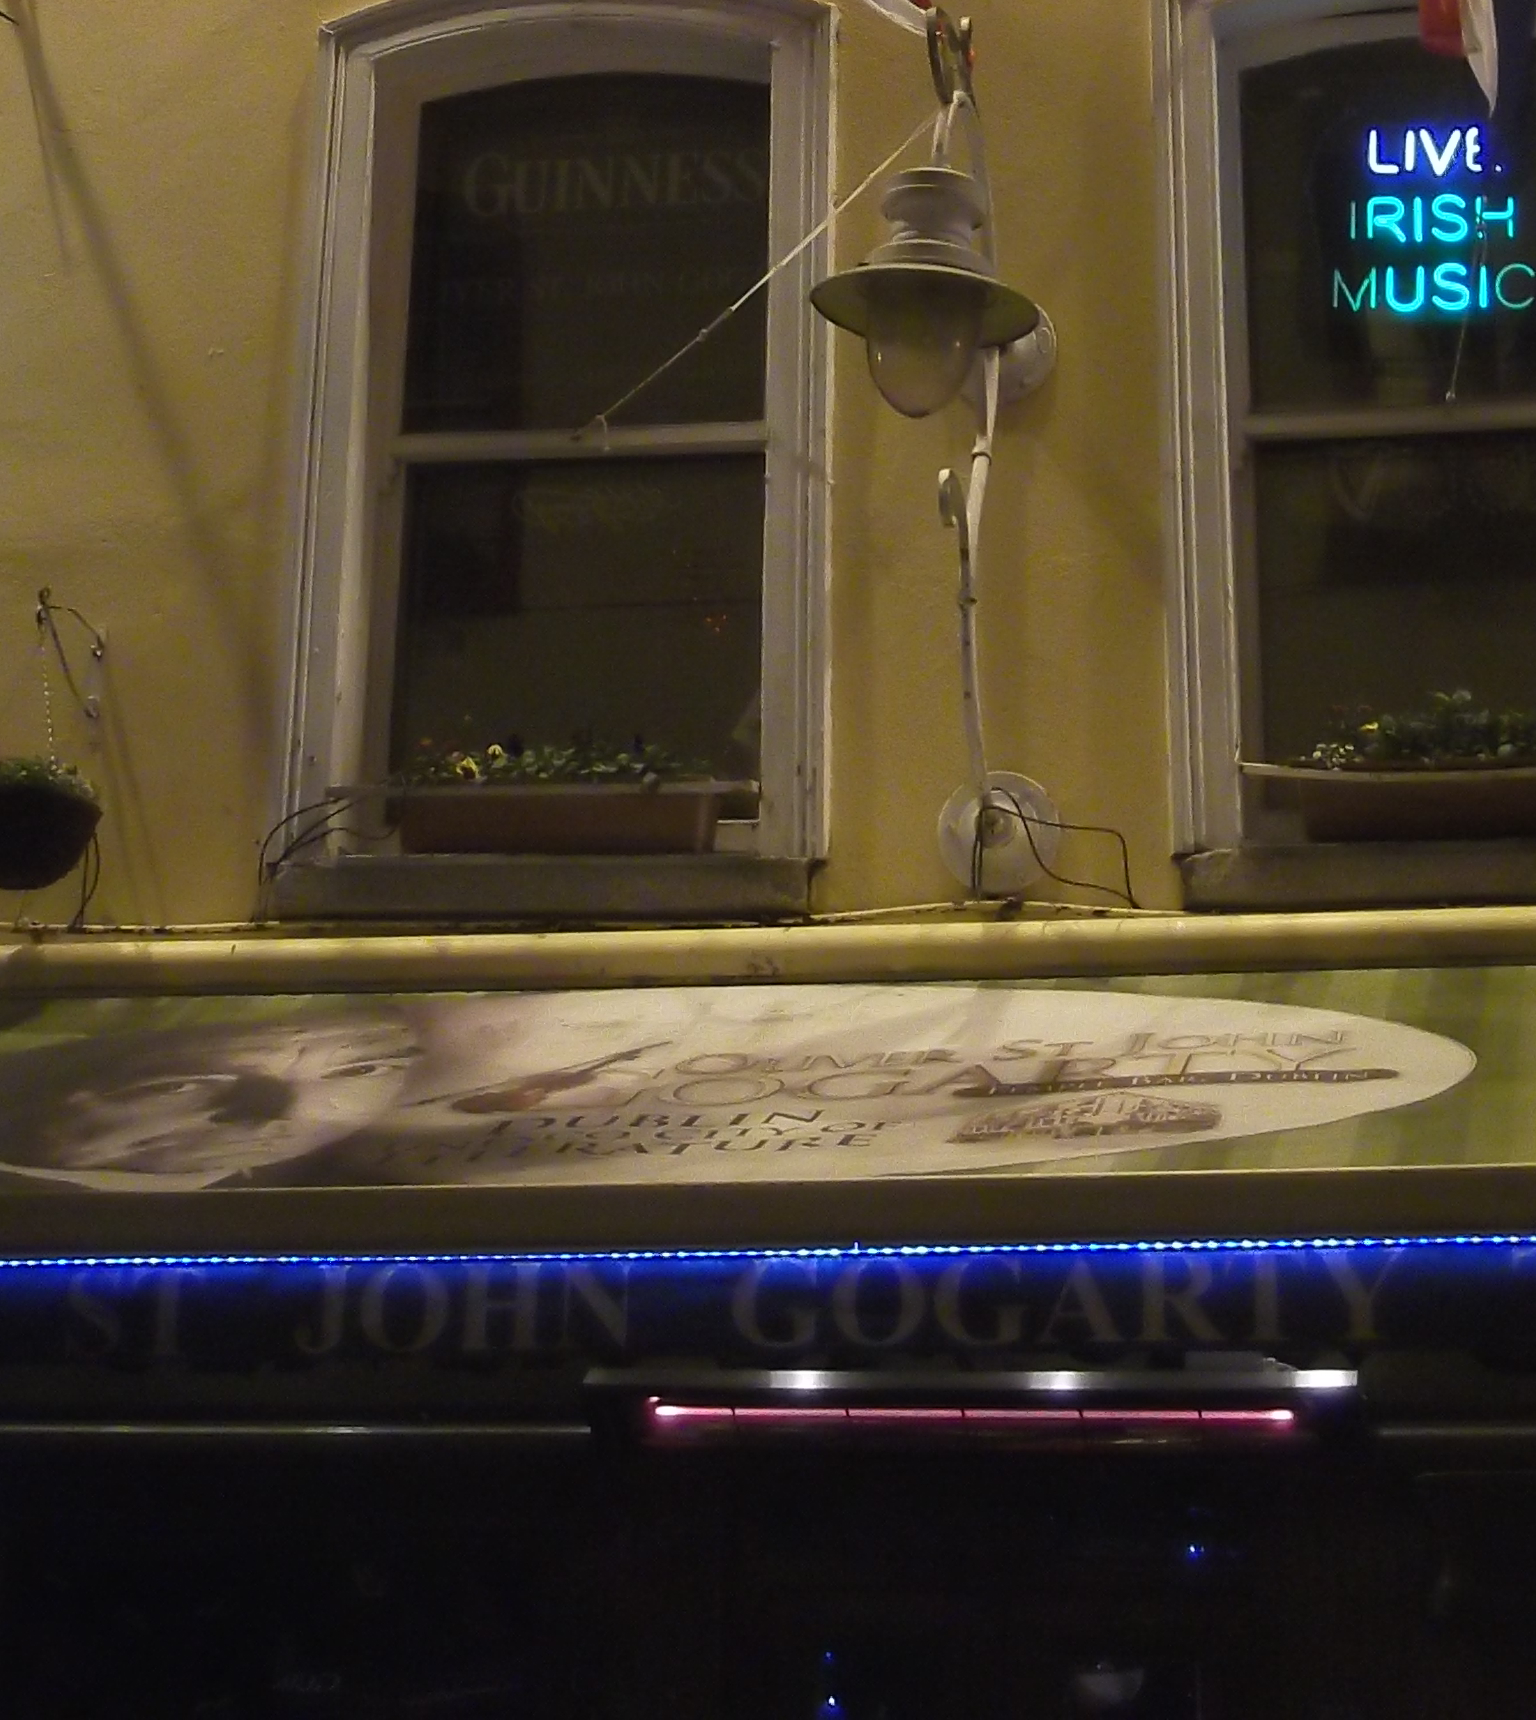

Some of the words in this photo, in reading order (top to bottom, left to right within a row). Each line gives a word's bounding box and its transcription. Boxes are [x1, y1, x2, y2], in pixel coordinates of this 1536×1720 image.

[461, 151, 766, 218] GUINNESS
[1350, 194, 1514, 243] IRISH
[1332, 262, 1536, 313] MUSIC
[293, 1260, 634, 1357] JOHN
[729, 1246, 1408, 1349] GOGARTY
